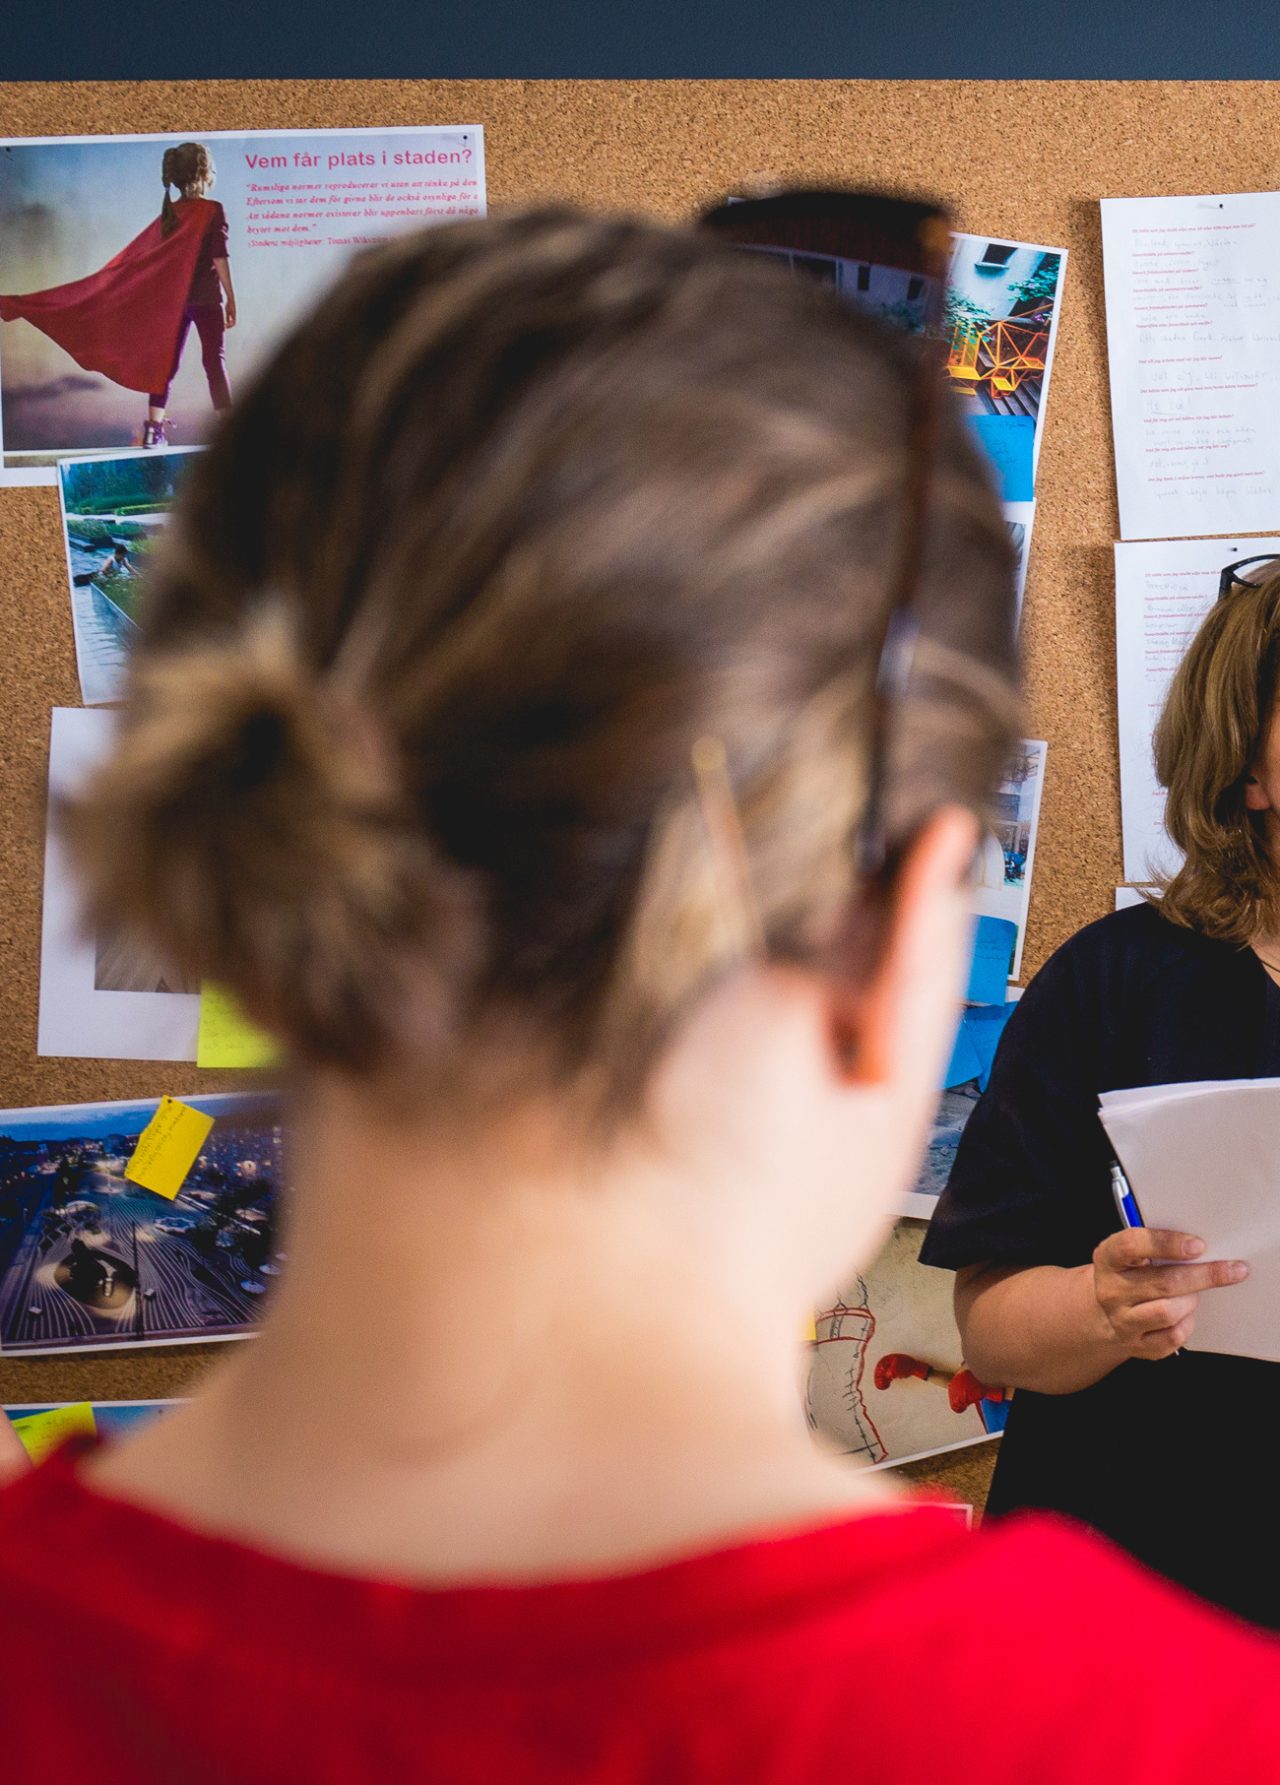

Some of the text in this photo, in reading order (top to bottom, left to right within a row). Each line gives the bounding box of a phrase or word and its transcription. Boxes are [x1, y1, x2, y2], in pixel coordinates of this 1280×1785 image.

[245, 154, 287, 169] Vem
[294, 151, 321, 168] får
[328, 150, 375, 170] plats
[394, 148, 472, 165] staden?
